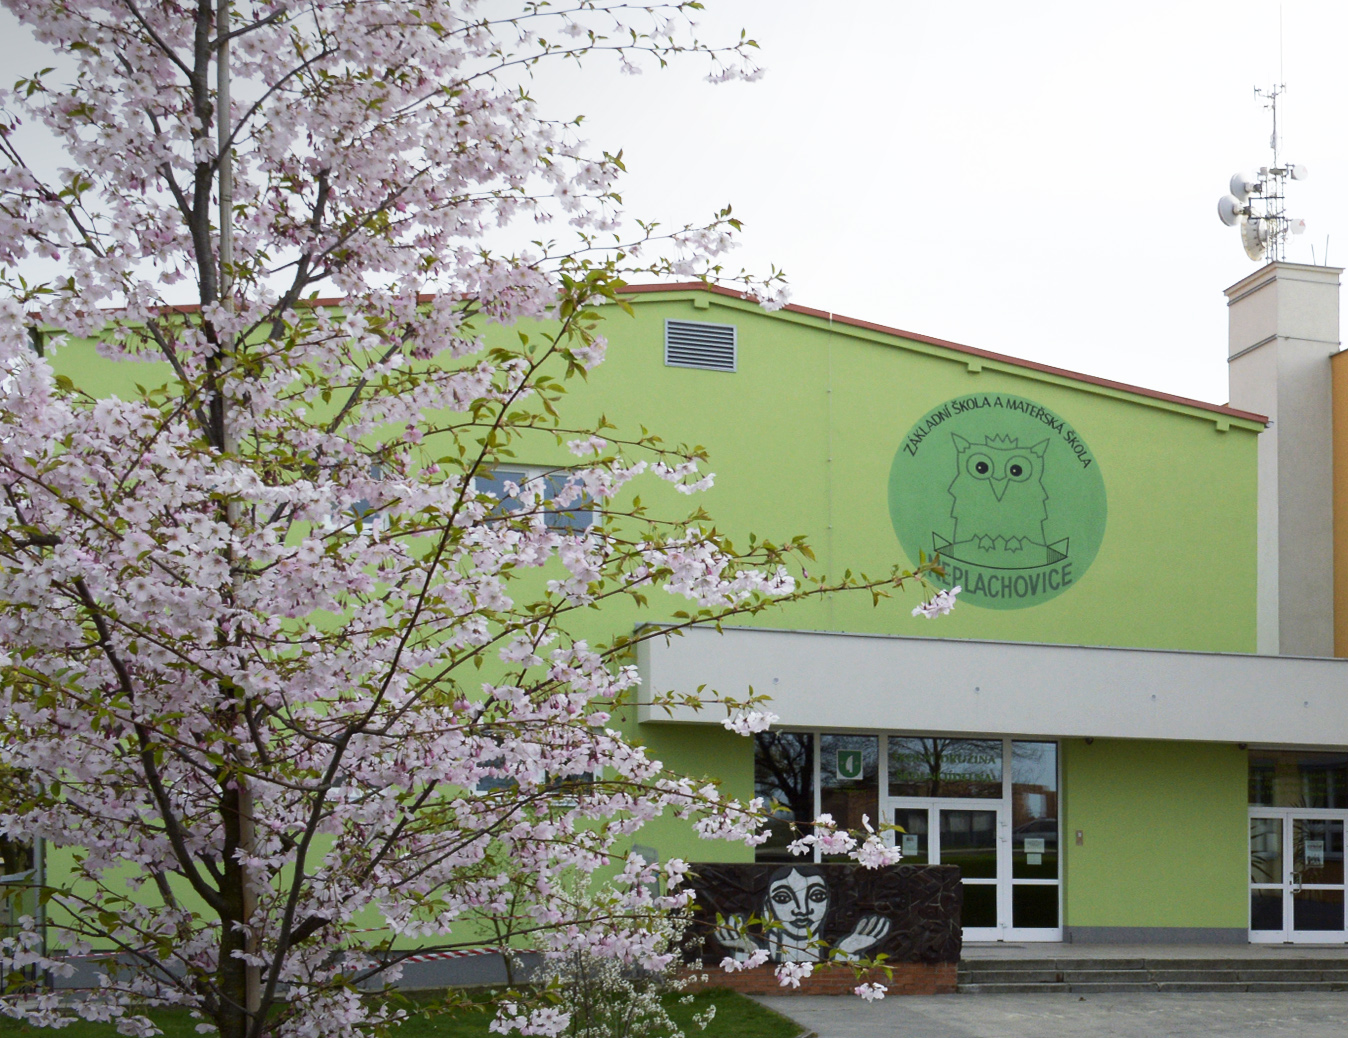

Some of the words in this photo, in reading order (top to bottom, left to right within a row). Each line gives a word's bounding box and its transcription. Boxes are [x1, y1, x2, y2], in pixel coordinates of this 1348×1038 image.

[903, 404, 952, 457] ZÁKLADNÍ
[952, 397, 991, 414] ŠKOLA
[993, 396, 1004, 408] A
[1006, 398, 1066, 435] MATEŘSKÁ
[1063, 430, 1092, 469] ŠKOLA
